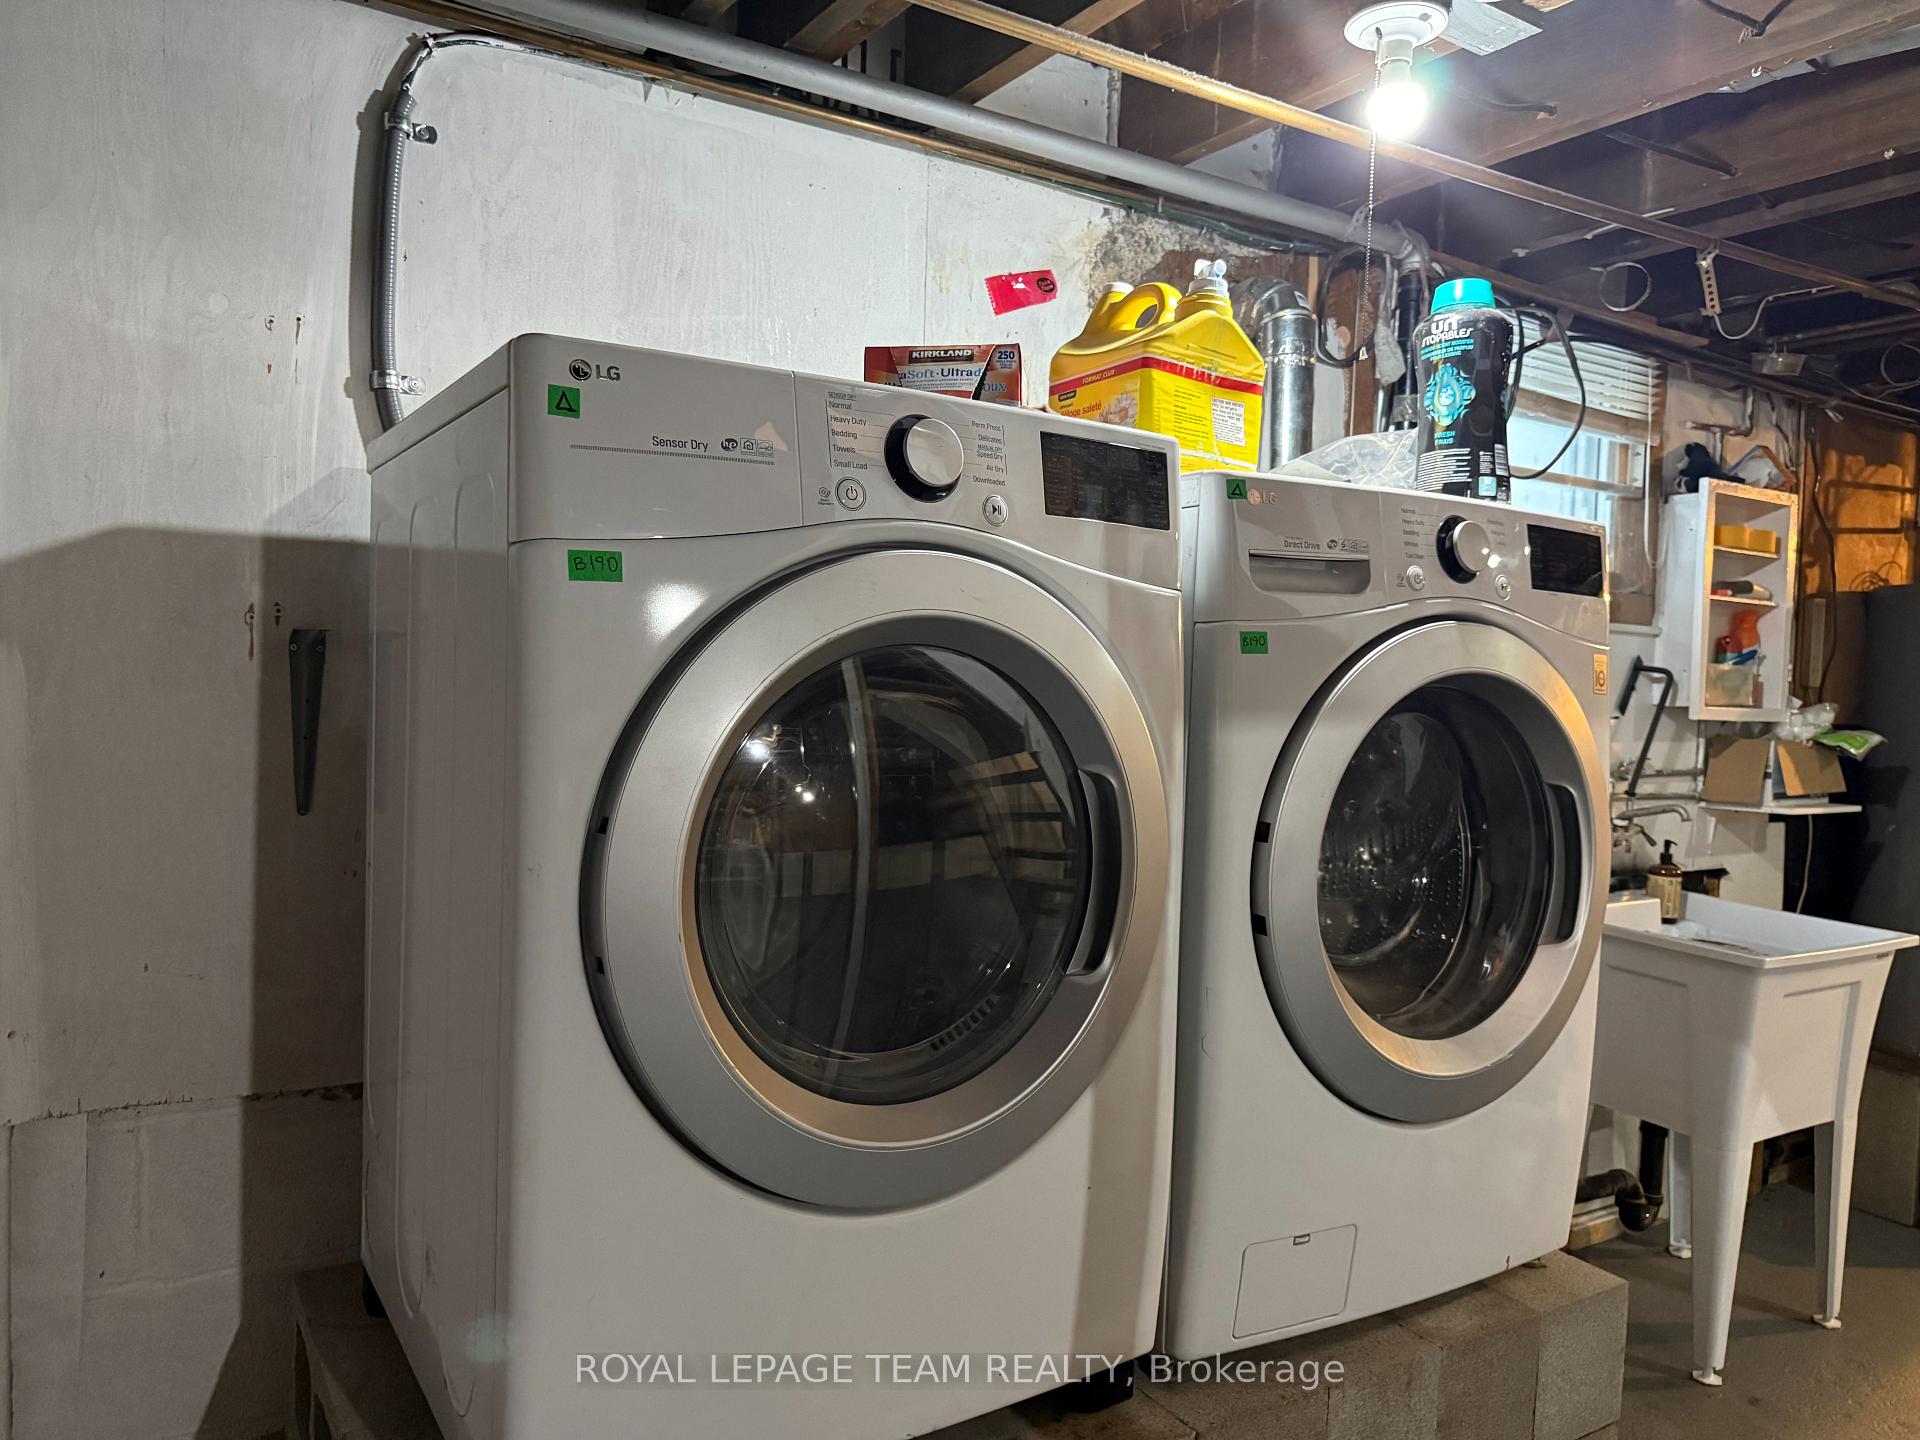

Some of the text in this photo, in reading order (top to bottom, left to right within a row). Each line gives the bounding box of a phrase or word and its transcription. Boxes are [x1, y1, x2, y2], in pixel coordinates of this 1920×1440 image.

[912, 349, 972, 359] KIRKLAND
[998, 351, 1015, 360] 250
[595, 364, 621, 382] LG
[829, 401, 852, 410] Normal
[830, 415, 867, 426] Heavy Duty
[831, 429, 858, 439] Bedding
[652, 436, 688, 449] Sensor
[691, 440, 709, 453] Dry
[832, 444, 856, 454] Towels
[834, 460, 868, 470] Small Load
[995, 465, 1004, 474] Dry
[973, 475, 1005, 487] Downloaded
[1284, 540, 1303, 549] Direct
[1304, 540, 1320, 550] Drive
[573, 555, 618, 573] B190
[1243, 636, 1265, 646] B190
